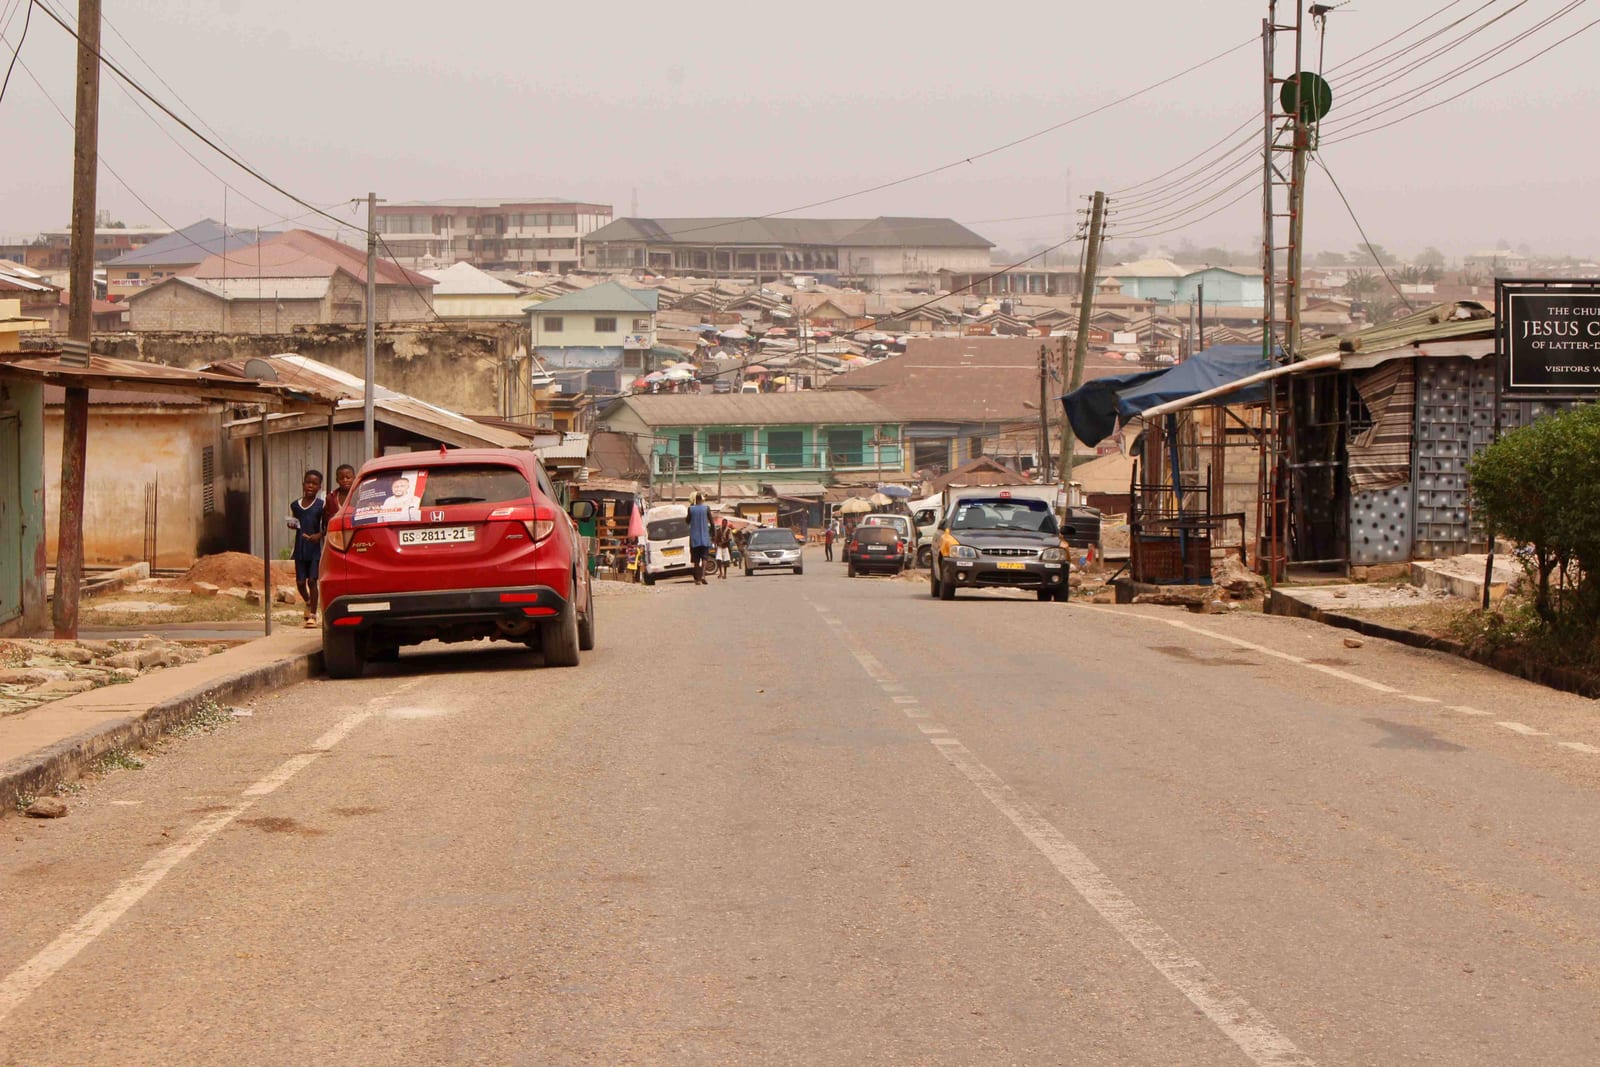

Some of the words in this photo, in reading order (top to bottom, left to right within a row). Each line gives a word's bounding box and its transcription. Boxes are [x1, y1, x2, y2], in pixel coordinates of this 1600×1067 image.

[1547, 307, 1570, 316] THE
[1522, 320, 1579, 339] JESUS
[1531, 341, 1546, 350] OF
[1545, 365, 1590, 373] VISITORS
